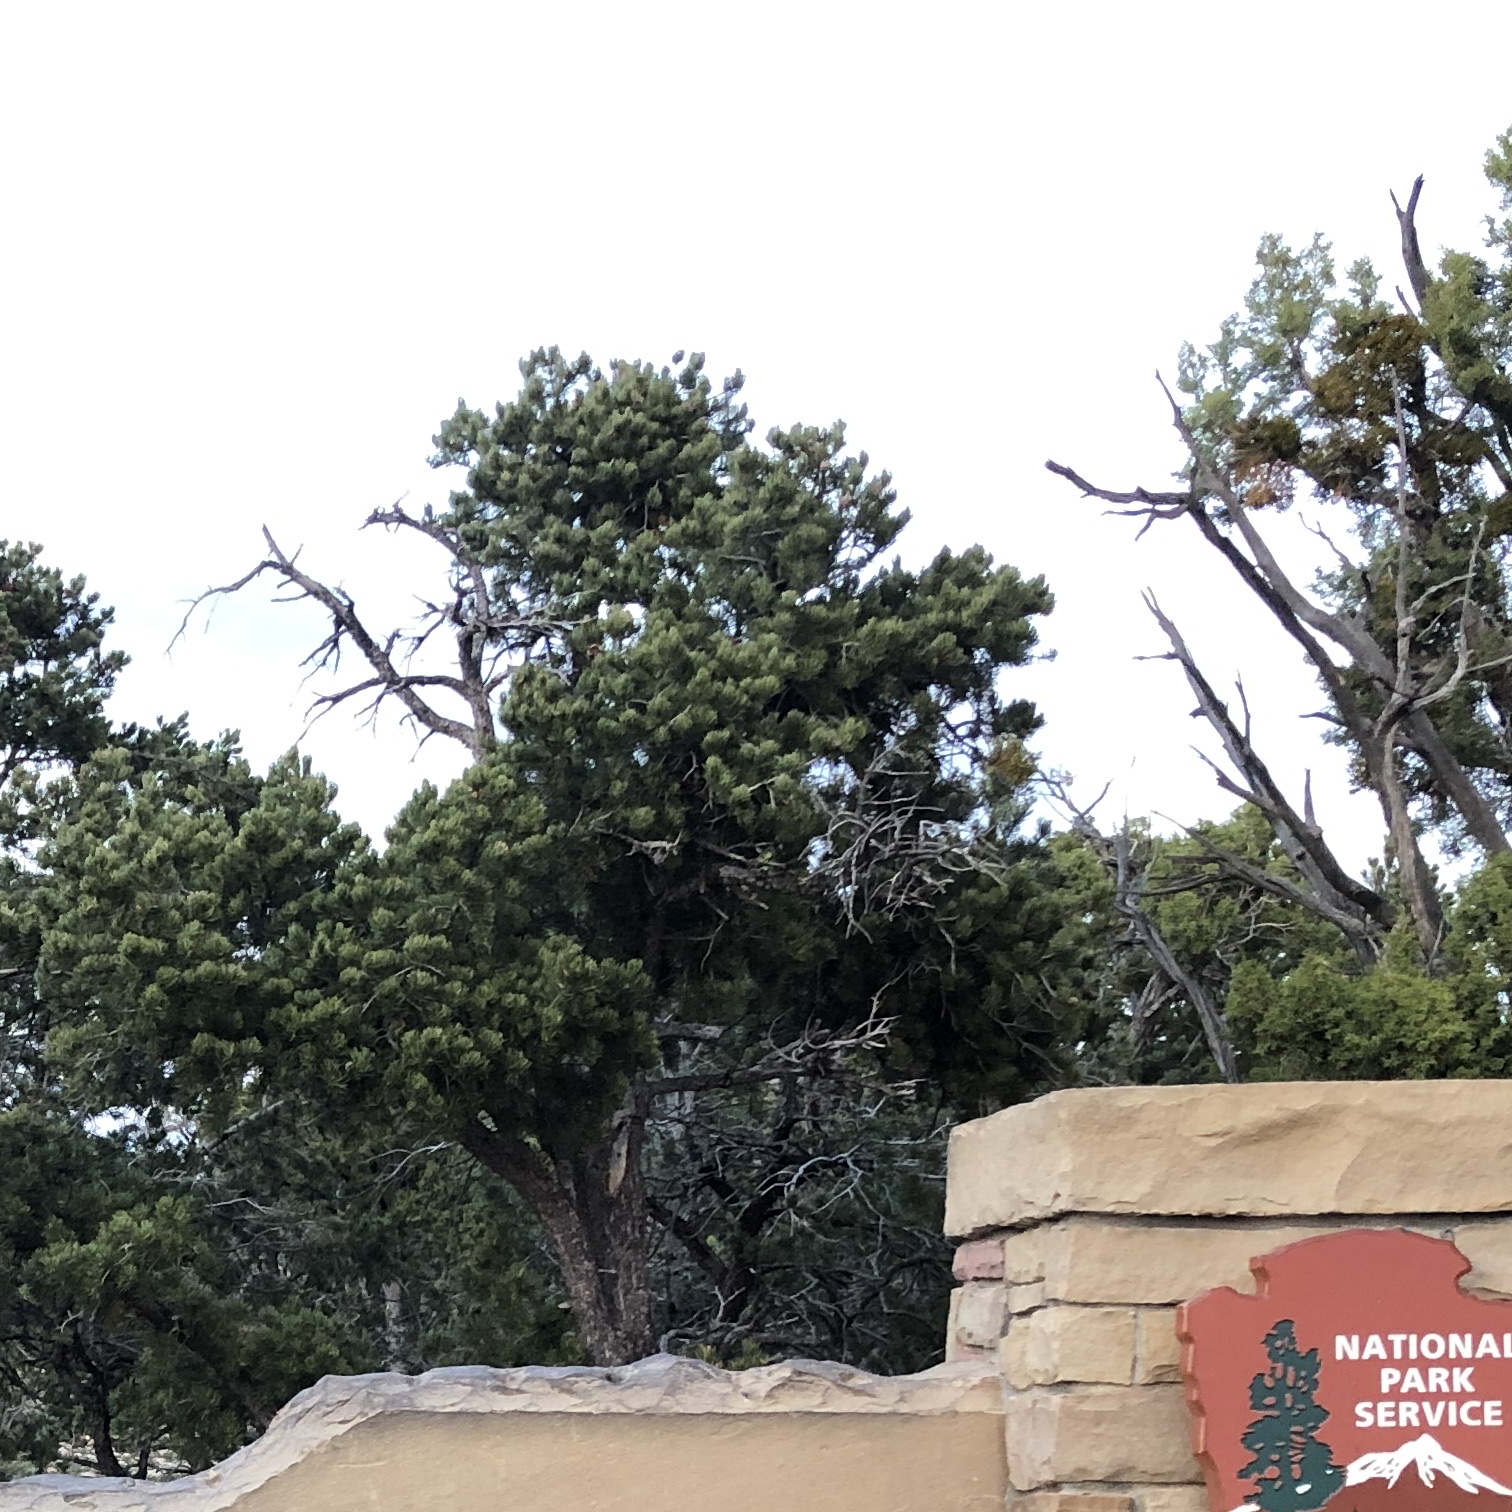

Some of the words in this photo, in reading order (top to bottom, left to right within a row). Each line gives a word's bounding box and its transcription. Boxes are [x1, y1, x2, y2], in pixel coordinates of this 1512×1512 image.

[1335, 1333, 1512, 1360] NATIONAL
[1380, 1367, 1476, 1393] PARK
[1354, 1401, 1504, 1427] SERVICE
